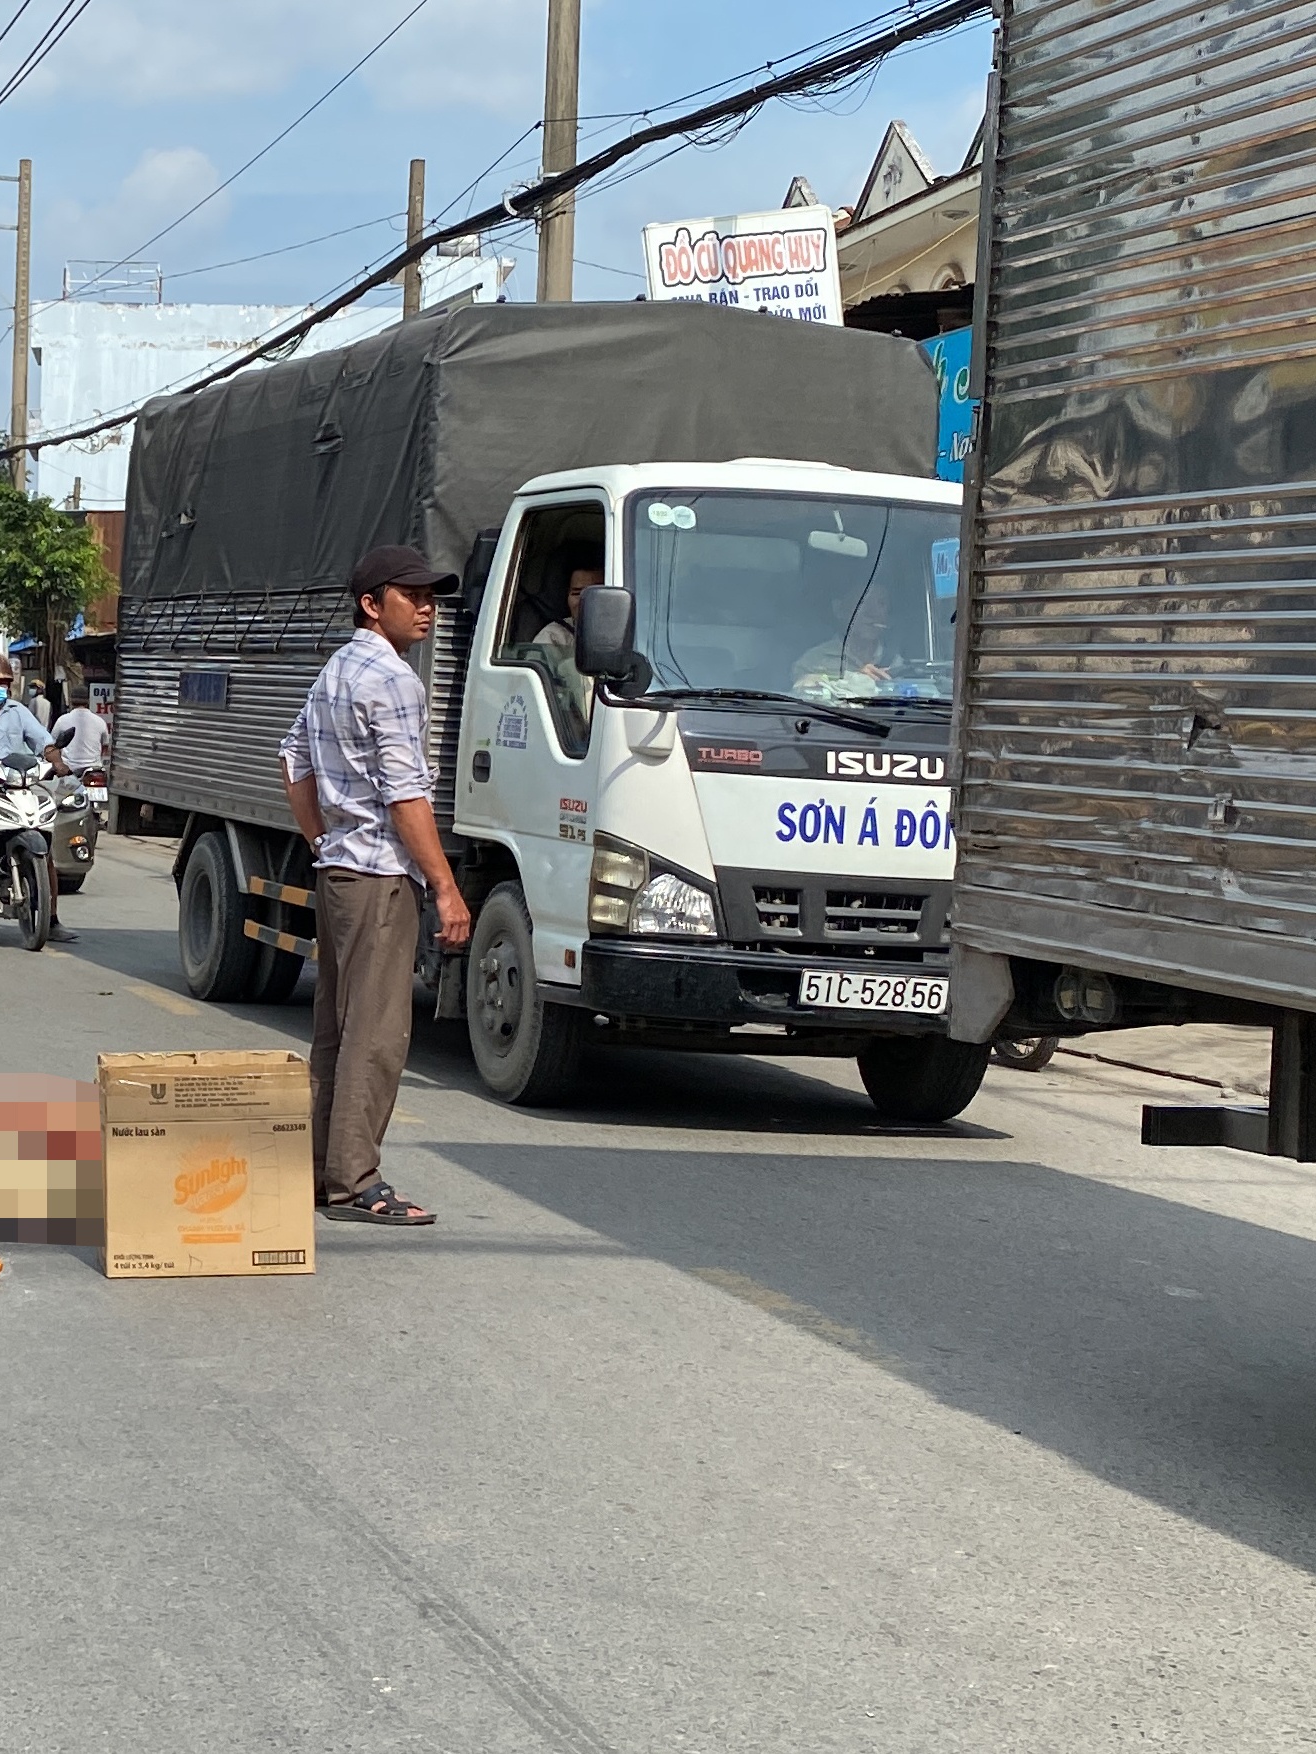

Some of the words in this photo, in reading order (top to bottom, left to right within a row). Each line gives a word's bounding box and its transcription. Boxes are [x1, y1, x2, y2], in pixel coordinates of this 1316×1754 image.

[723, 236, 785, 281] QUANG
[787, 232, 823, 270] HUY
[753, 285, 790, 302] TRAO
[698, 748, 763, 762] TURBO
[826, 751, 945, 780] ISUZU
[775, 798, 846, 845] SƠN
[857, 797, 880, 846] Á
[112, 1127, 134, 1137] Nước
[135, 1127, 149, 1137] lau
[151, 1126, 166, 1137] sàn
[173, 1156, 248, 1206] Sunlight
